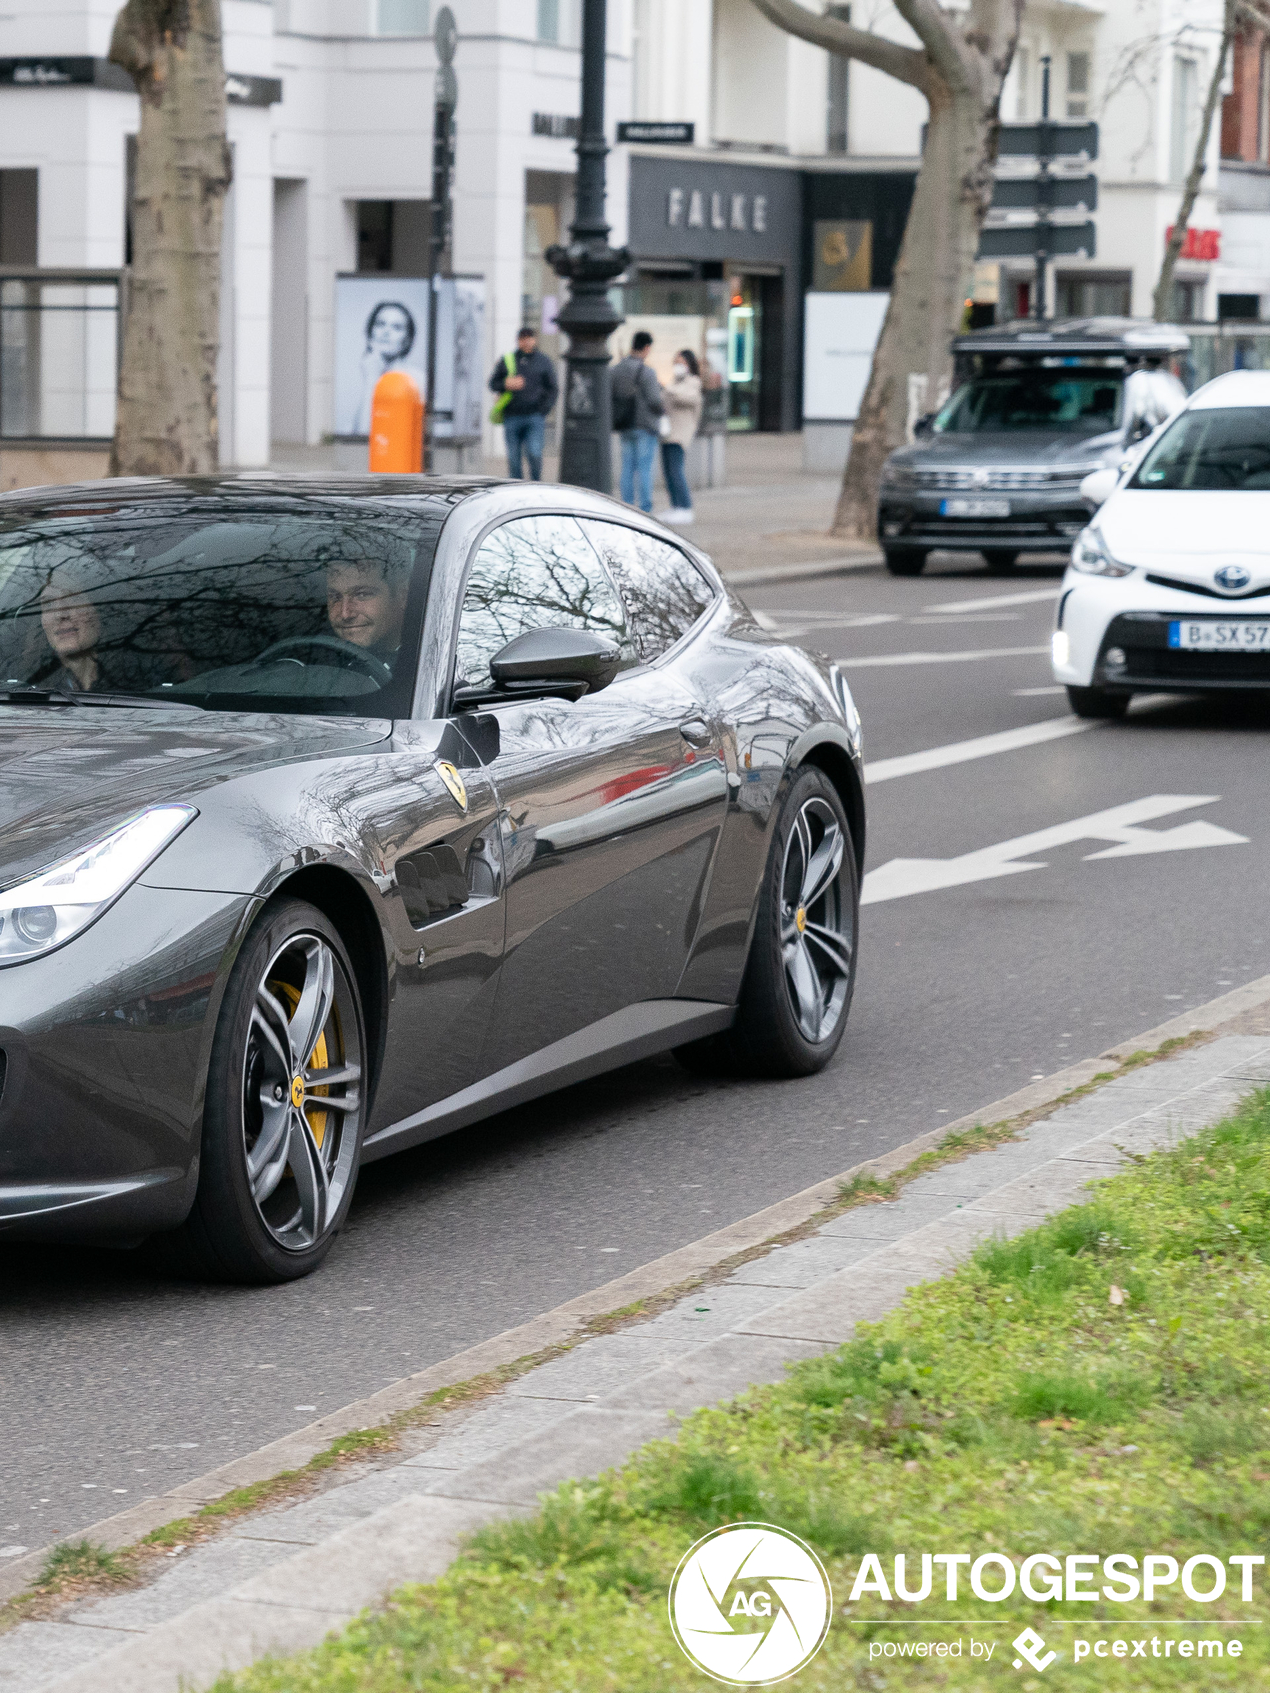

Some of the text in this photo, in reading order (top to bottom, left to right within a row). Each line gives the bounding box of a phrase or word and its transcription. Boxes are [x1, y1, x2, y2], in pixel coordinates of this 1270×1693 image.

[668, 187, 768, 233] FALKE
[1189, 626, 1201, 643] B
[1215, 626, 1240, 644] SX
